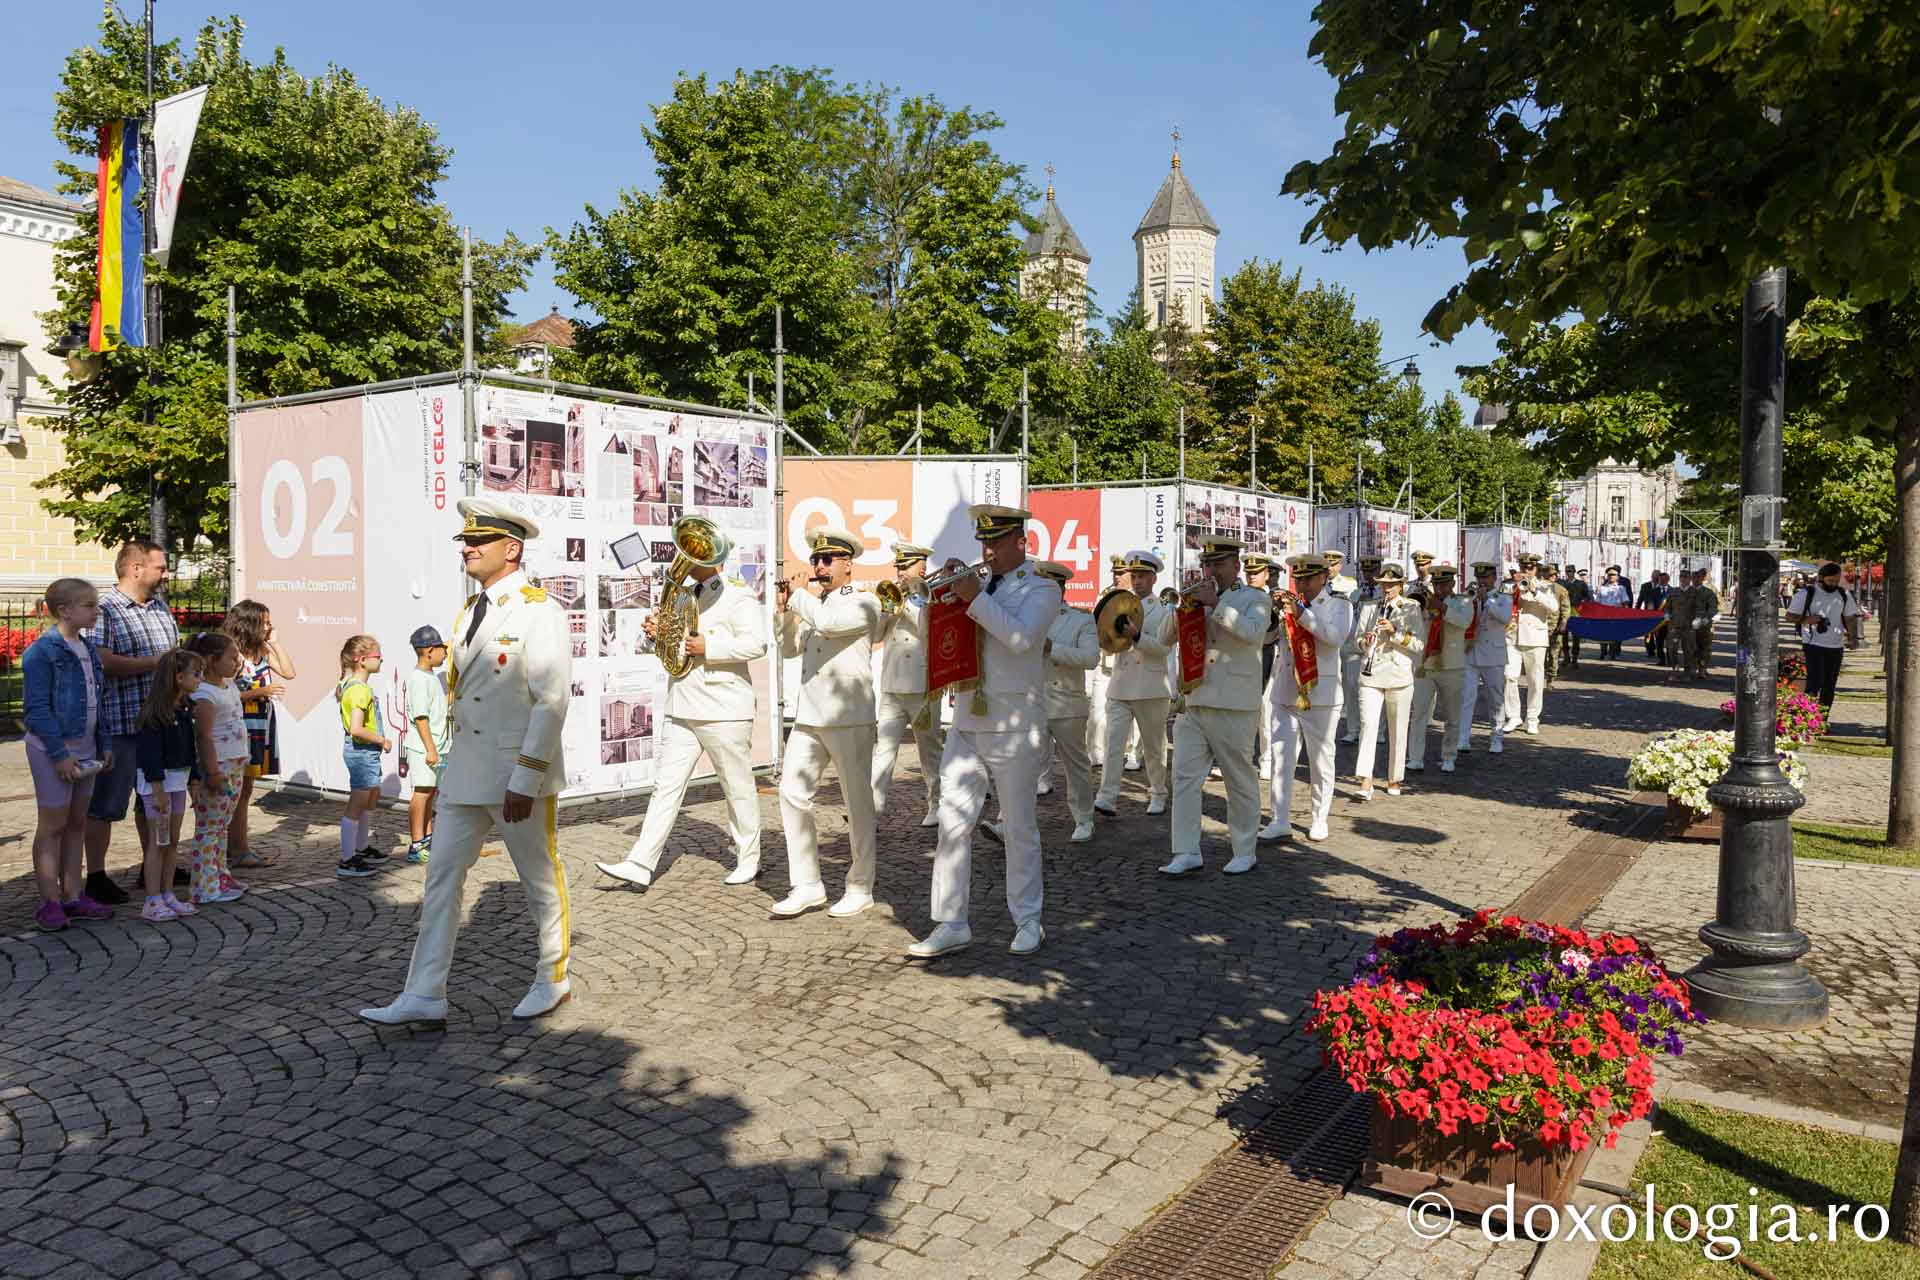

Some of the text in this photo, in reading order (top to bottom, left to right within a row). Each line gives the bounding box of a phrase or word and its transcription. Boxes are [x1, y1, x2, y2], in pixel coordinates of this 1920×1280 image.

[260, 456, 355, 559] 02
[787, 497, 899, 567] 03
[1155, 494, 1164, 543] HOLCIM
